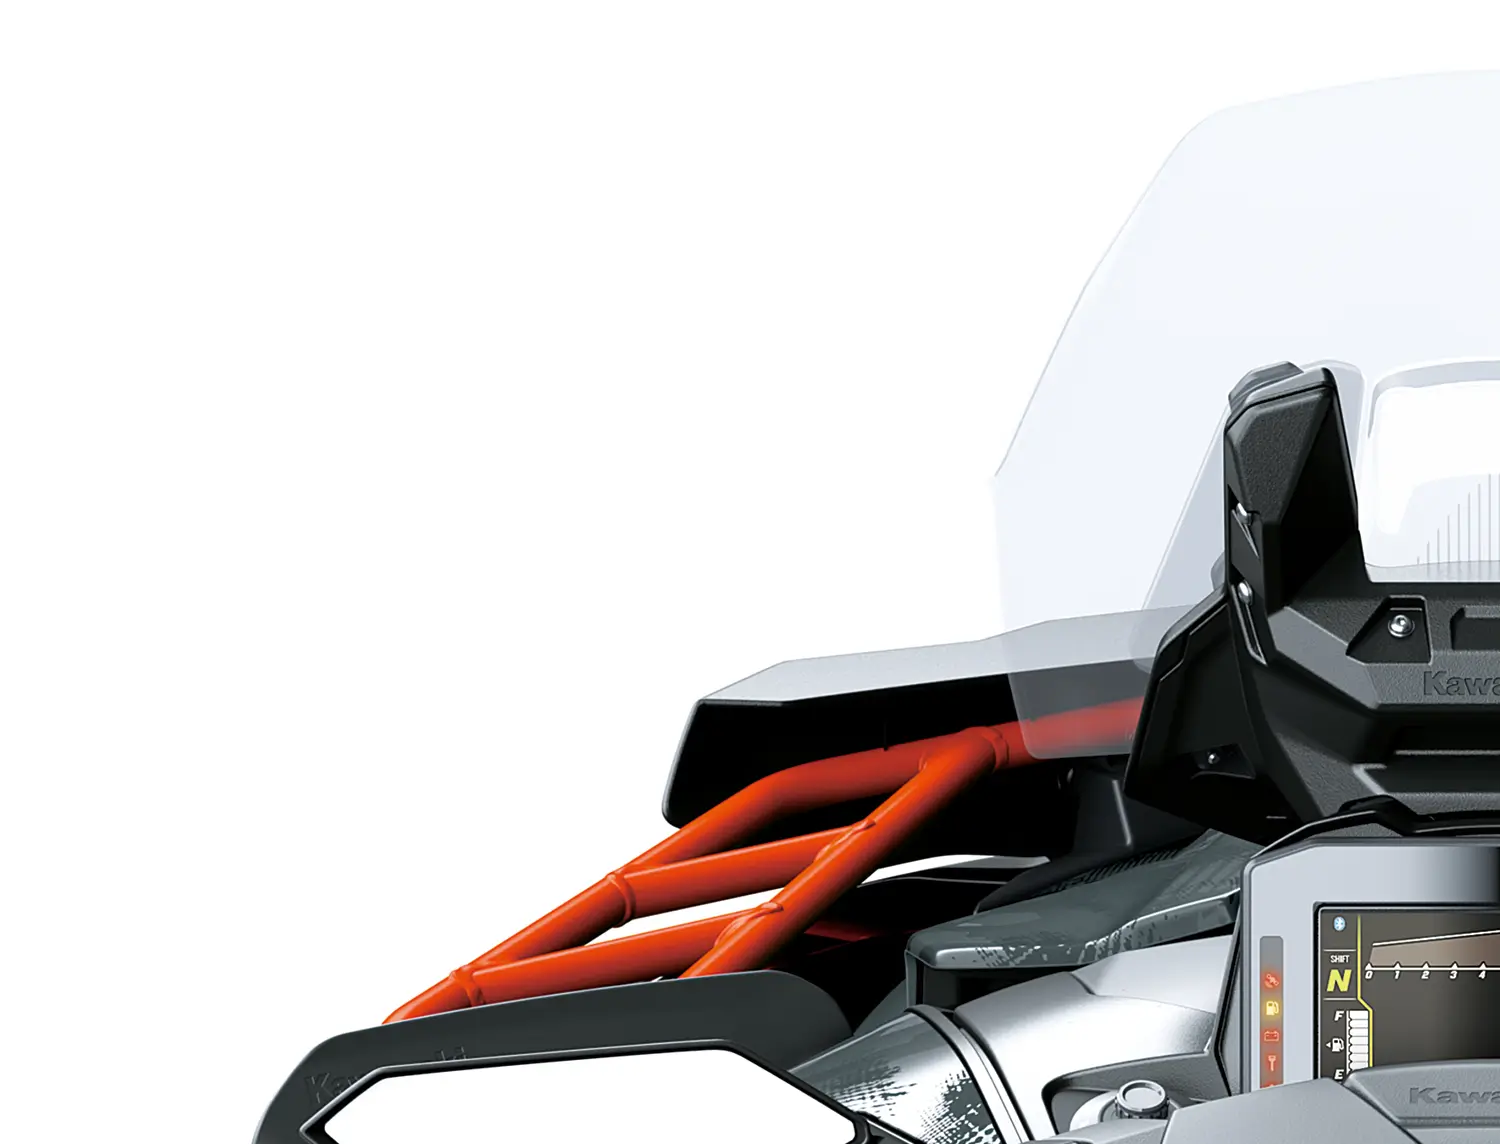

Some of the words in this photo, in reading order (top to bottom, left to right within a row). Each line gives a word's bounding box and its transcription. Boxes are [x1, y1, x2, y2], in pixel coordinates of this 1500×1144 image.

[1330, 955, 1350, 963] SHIFT
[1365, 970, 1372, 979] 0
[1422, 970, 1430, 979] 2
[1450, 970, 1458, 979] 3
[1478, 970, 1486, 979] 4
[1326, 969, 1352, 992] N
[1334, 1011, 1345, 1021] F
[1334, 1070, 1344, 1080] E
